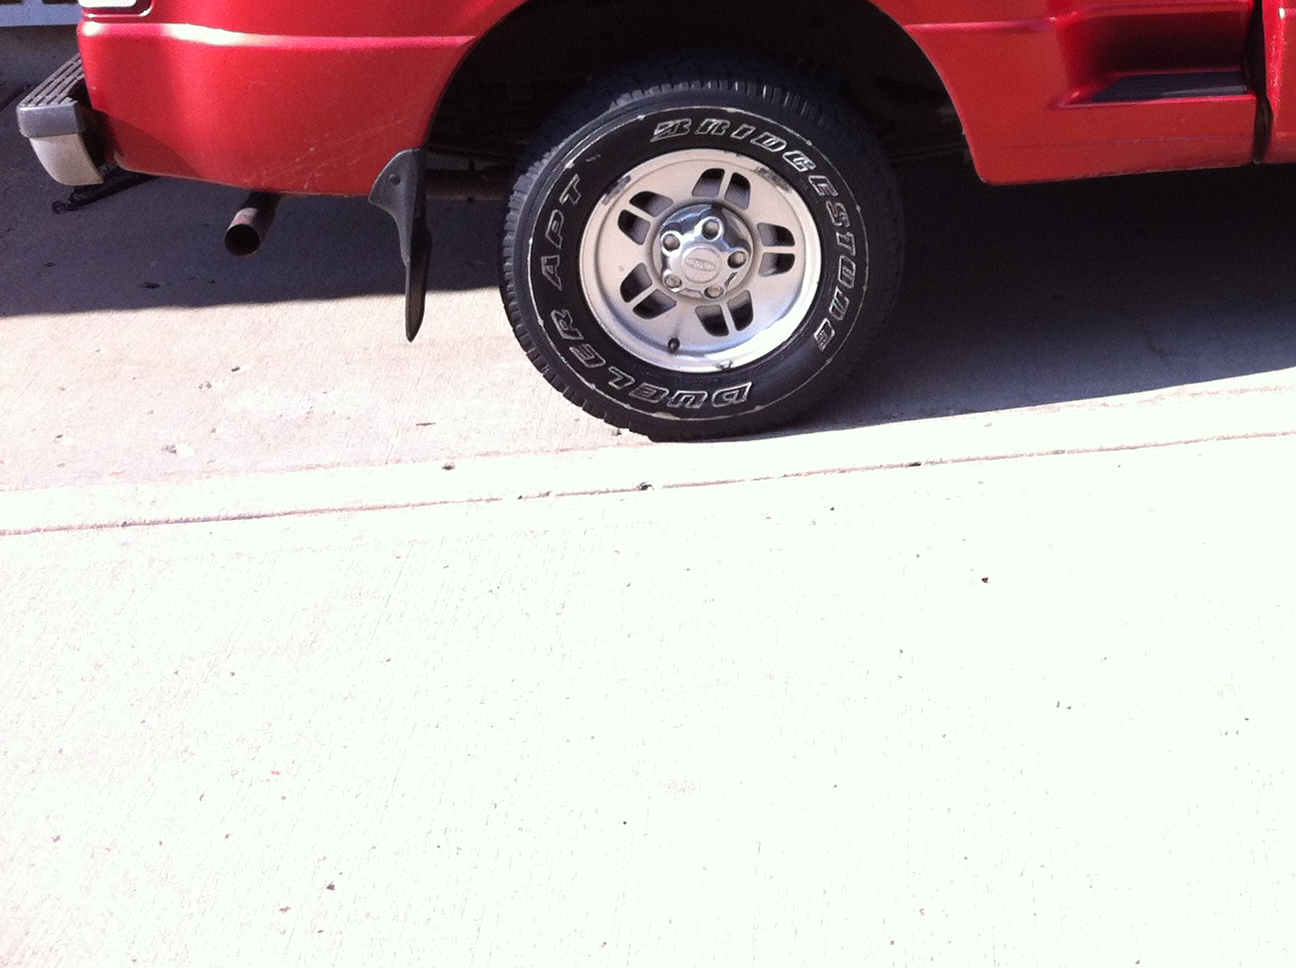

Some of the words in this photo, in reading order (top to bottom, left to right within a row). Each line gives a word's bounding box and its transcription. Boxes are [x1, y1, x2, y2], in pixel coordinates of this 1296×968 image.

[541, 174, 583, 291] APT
[650, 118, 857, 351] BRIDGESTONE
[550, 308, 753, 410] DUELER
